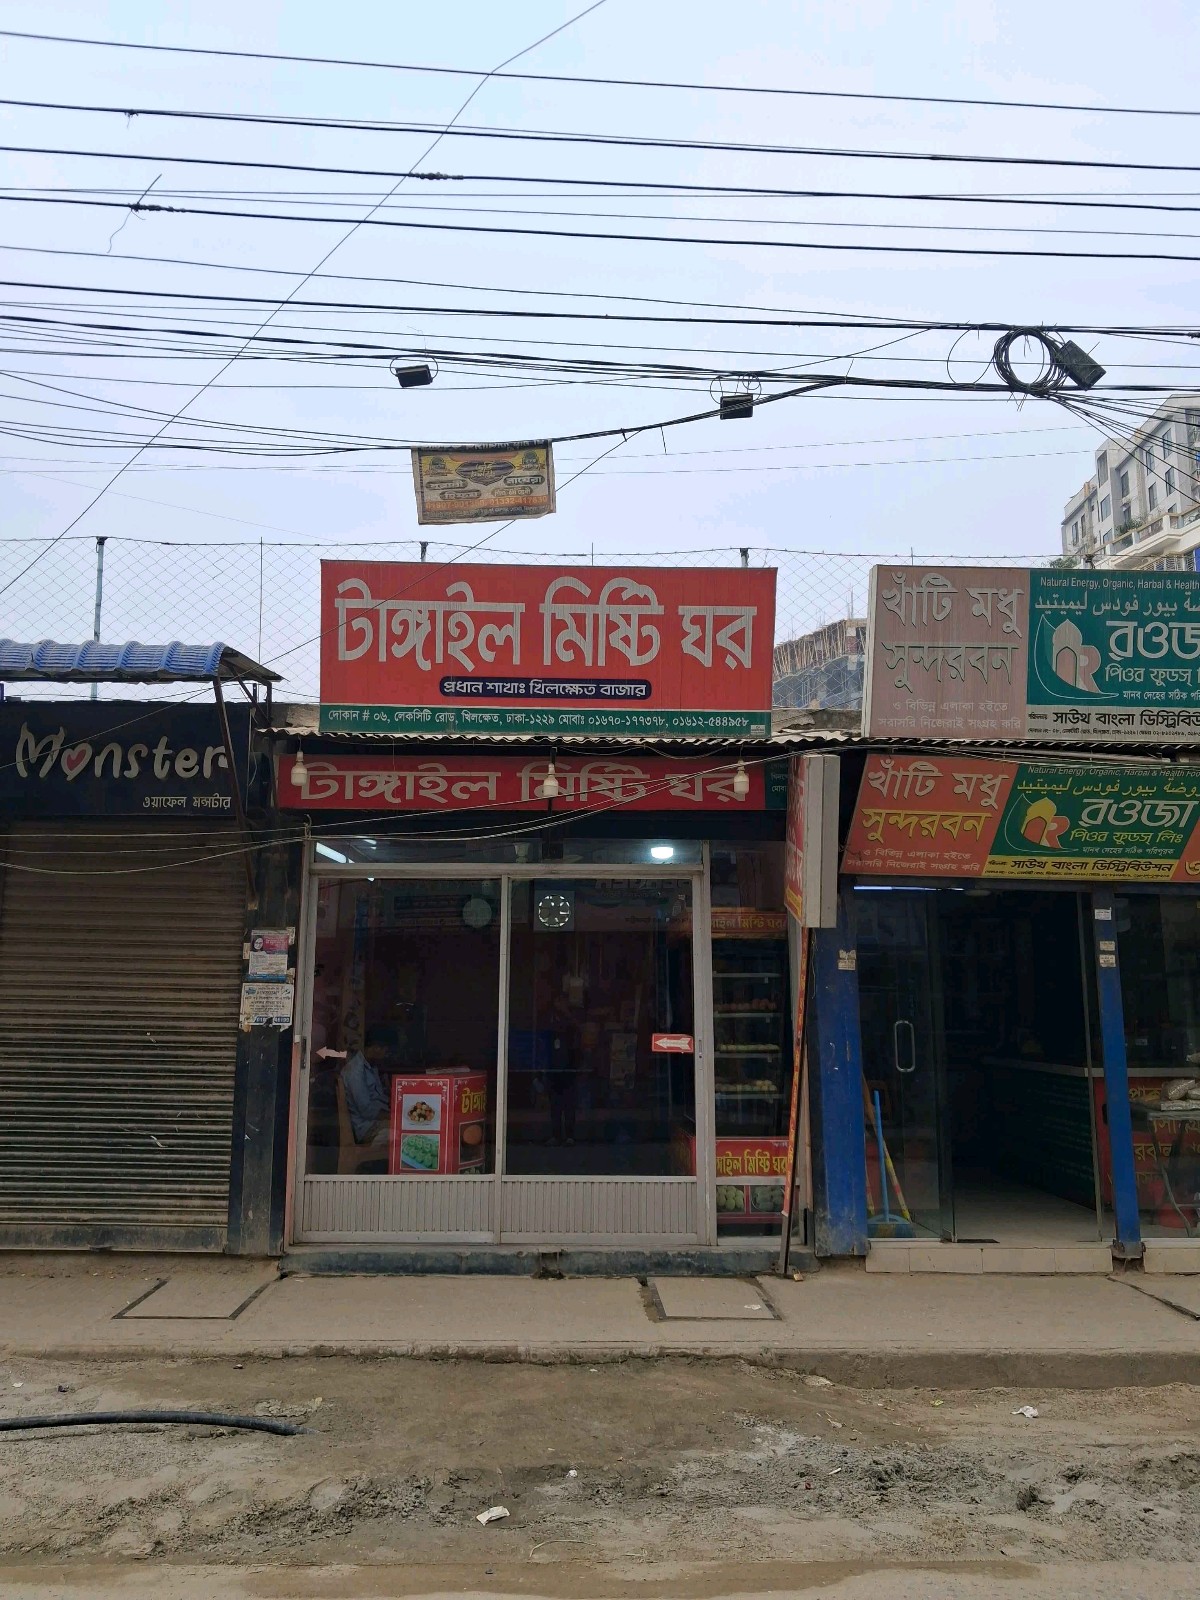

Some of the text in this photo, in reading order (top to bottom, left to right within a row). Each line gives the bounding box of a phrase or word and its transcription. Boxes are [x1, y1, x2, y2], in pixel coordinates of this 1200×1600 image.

[1040, 577, 1200, 590] Natural Energy, Organic, Harbal & Health
[882, 571, 1025, 639] খাঁটি মধু
[334, 576, 757, 672] টাঙ্গাইল মিষ্টি ঘর
[1106, 620, 1200, 662] রওজ
[881, 642, 1019, 693] সুন্দরবন
[1105, 662, 1145, 683] পিওর
[443, 679, 646, 697] প্রধান শাখাঃ খিলক্ষেত বাজার
[328, 709, 360, 721] দোকান
[362, 710, 370, 721] #
[394, 708, 432, 722] লেকসিটি
[1052, 708, 1091, 724] সাউথ
[1095, 711, 1136, 727] বাংলা
[868, 759, 1011, 810] খাঁটি মধু
[862, 808, 995, 843] সুন্দরবন
[1078, 798, 1199, 828] রওজা
[1070, 827, 1109, 843] পিওর
[1010, 858, 1048, 869] সাউথ
[1051, 860, 1088, 872] বাংলা
